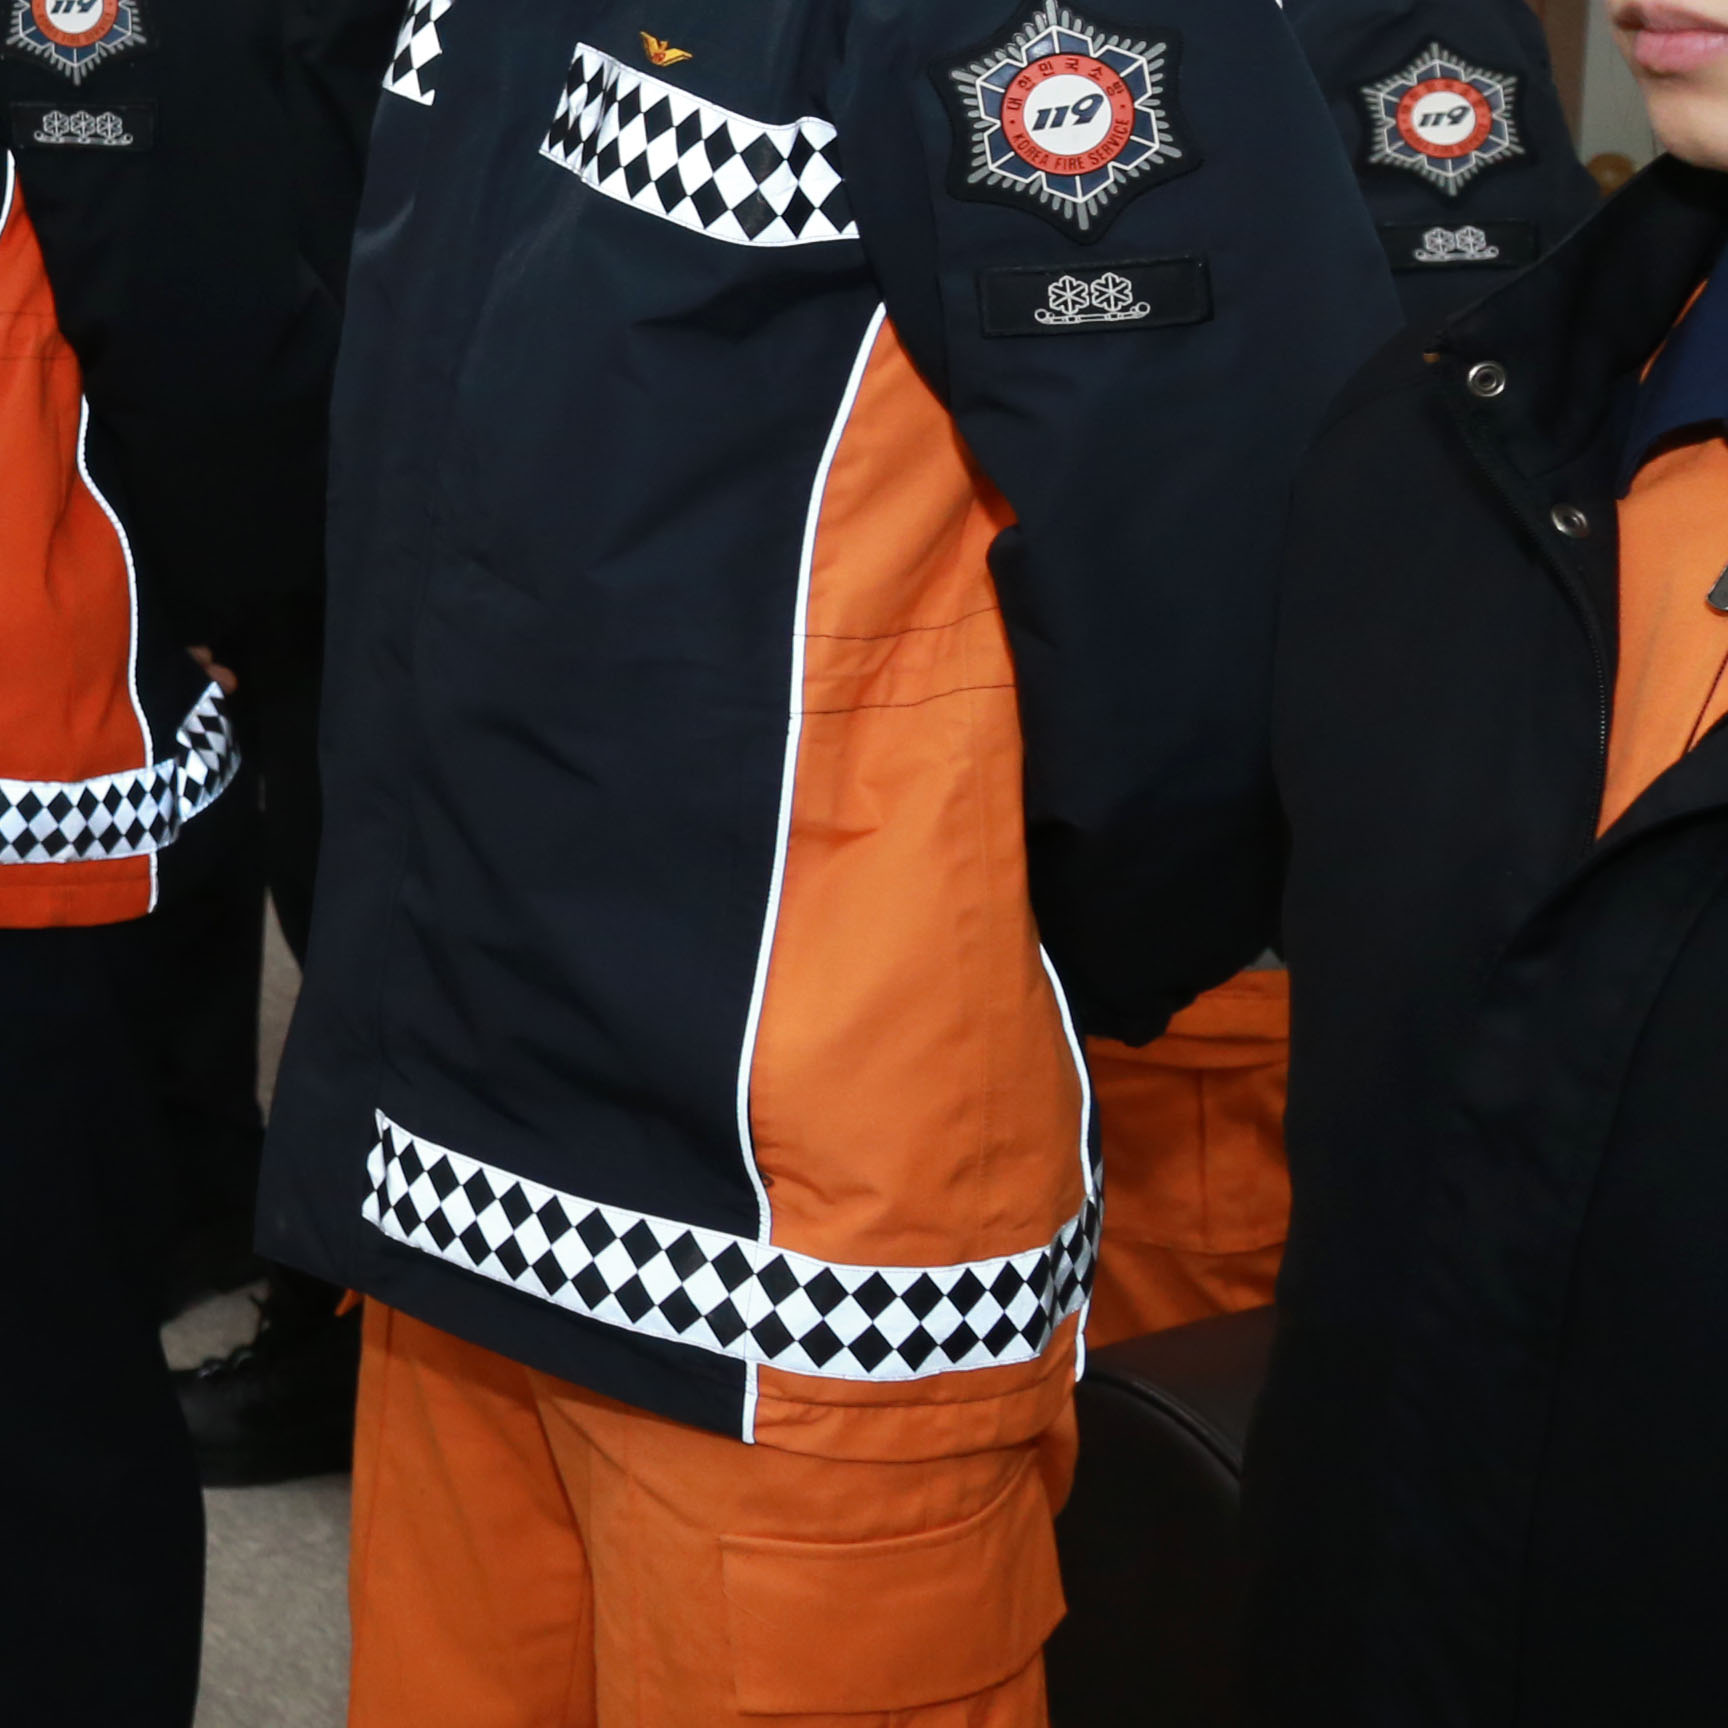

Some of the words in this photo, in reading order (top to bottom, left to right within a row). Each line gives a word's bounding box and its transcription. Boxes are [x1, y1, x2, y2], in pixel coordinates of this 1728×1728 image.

[1006, 56, 1125, 111] 대한민국소방
[1031, 93, 1104, 132] 119
[1418, 105, 1471, 127] 119
[1012, 132, 1048, 167] KOREA
[1054, 157, 1085, 171] FIRE
[1087, 117, 1130, 166] SERVICE
